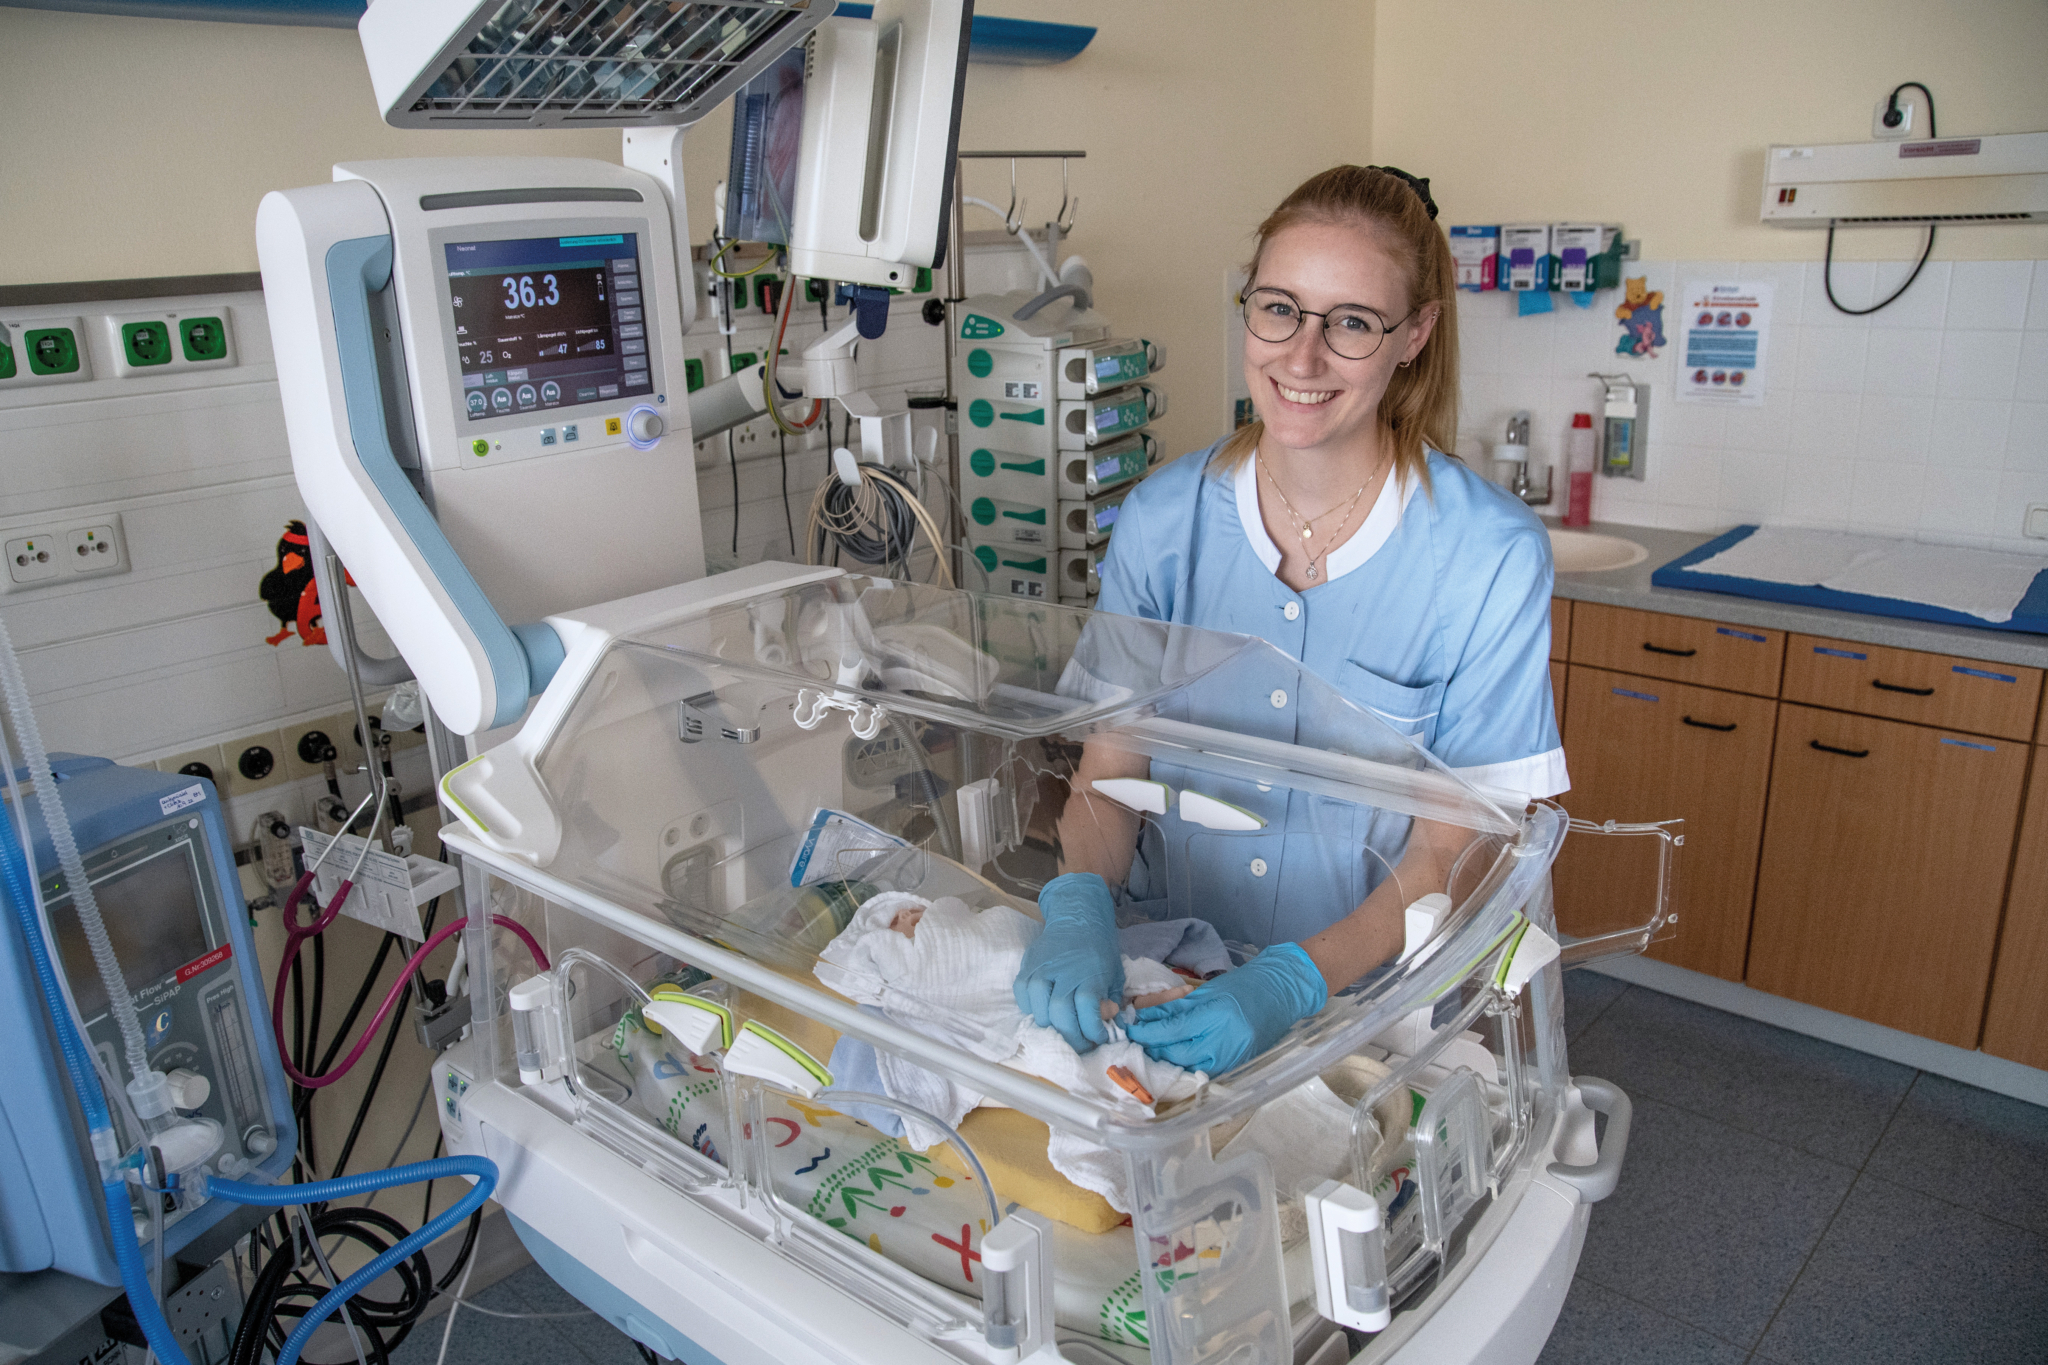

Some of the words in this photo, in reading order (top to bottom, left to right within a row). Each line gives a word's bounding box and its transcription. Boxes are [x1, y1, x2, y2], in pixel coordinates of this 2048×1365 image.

[502, 274, 560, 309] 36.3
[558, 343, 568, 354] 47
[595, 339, 606, 350] 85
[479, 350, 493, 364] 25
[470, 398, 483, 406] 37.0
[798, 838, 816, 868] vyaire
[139, 982, 162, 1000] Flow
[153, 985, 182, 1006] SiPAP
[206, 993, 220, 1004] Pres
[220, 984, 234, 996] High
